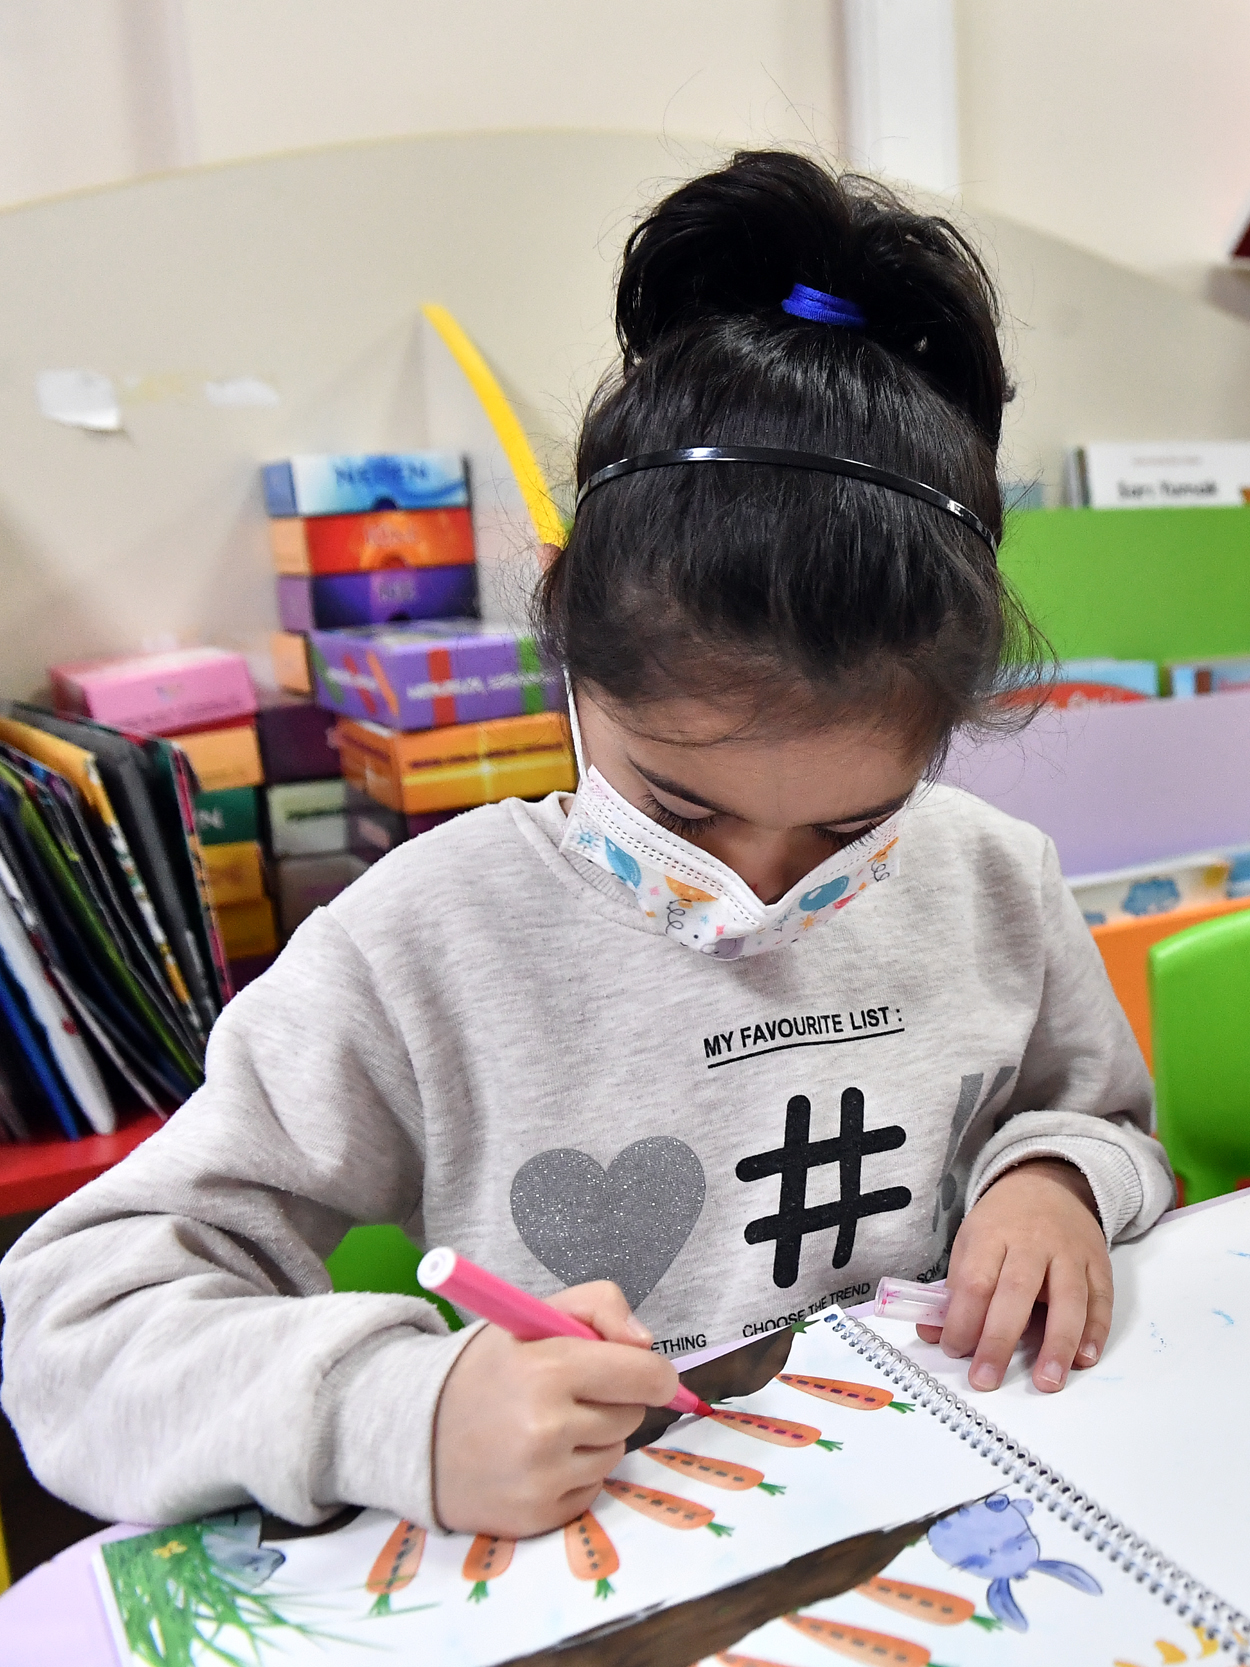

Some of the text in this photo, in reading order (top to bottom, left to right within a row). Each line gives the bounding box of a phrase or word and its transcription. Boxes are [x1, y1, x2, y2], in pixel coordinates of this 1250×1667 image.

[703, 1030, 734, 1059] MY
[739, 1013, 844, 1048] FAVOURITE
[849, 1006, 889, 1031] LIST
[742, 1282, 871, 1339] CHOOSE THE TREND
[650, 1332, 707, 1355] ETHING
